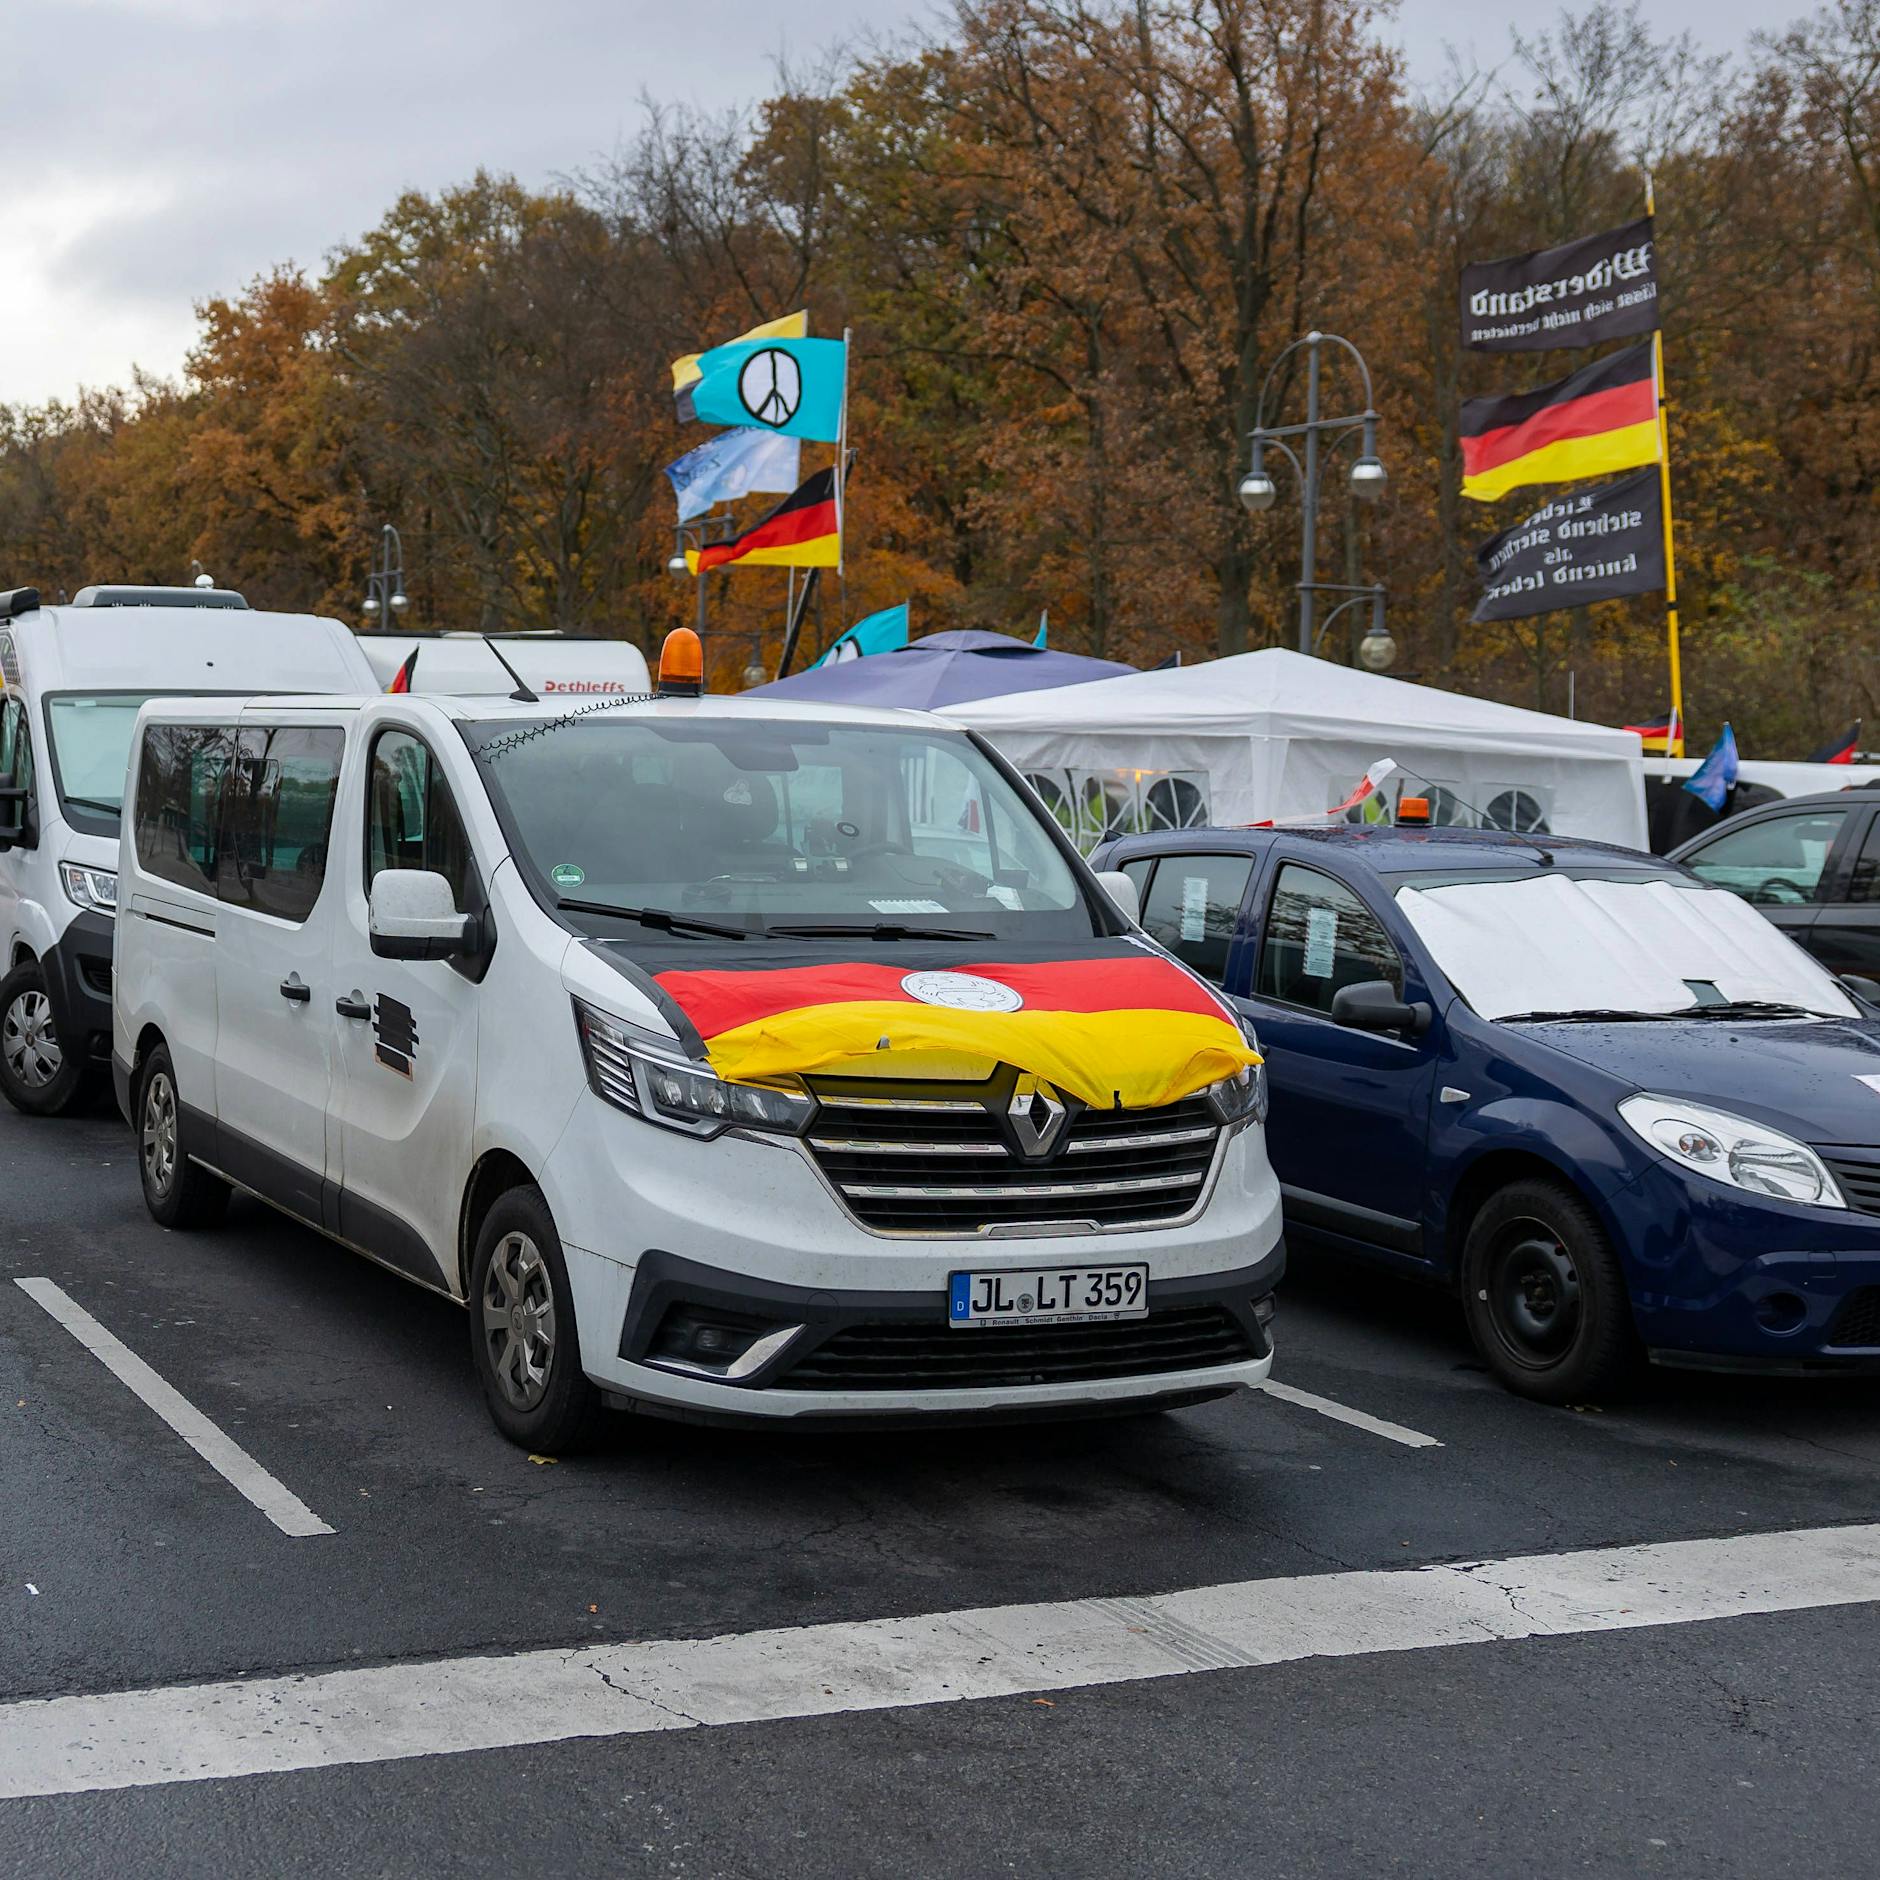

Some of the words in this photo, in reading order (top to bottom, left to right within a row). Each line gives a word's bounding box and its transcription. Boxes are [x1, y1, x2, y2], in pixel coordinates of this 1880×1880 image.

[544, 680, 625, 693] Dethleffs
[972, 1277, 1014, 1312] JL
[1037, 1274, 1077, 1309] LT
[1084, 1271, 1142, 1307] 359
[992, 1318, 1019, 1326] Renault
[1025, 1316, 1053, 1325] Schmidt
[1088, 1313, 1108, 1321] Dacia
